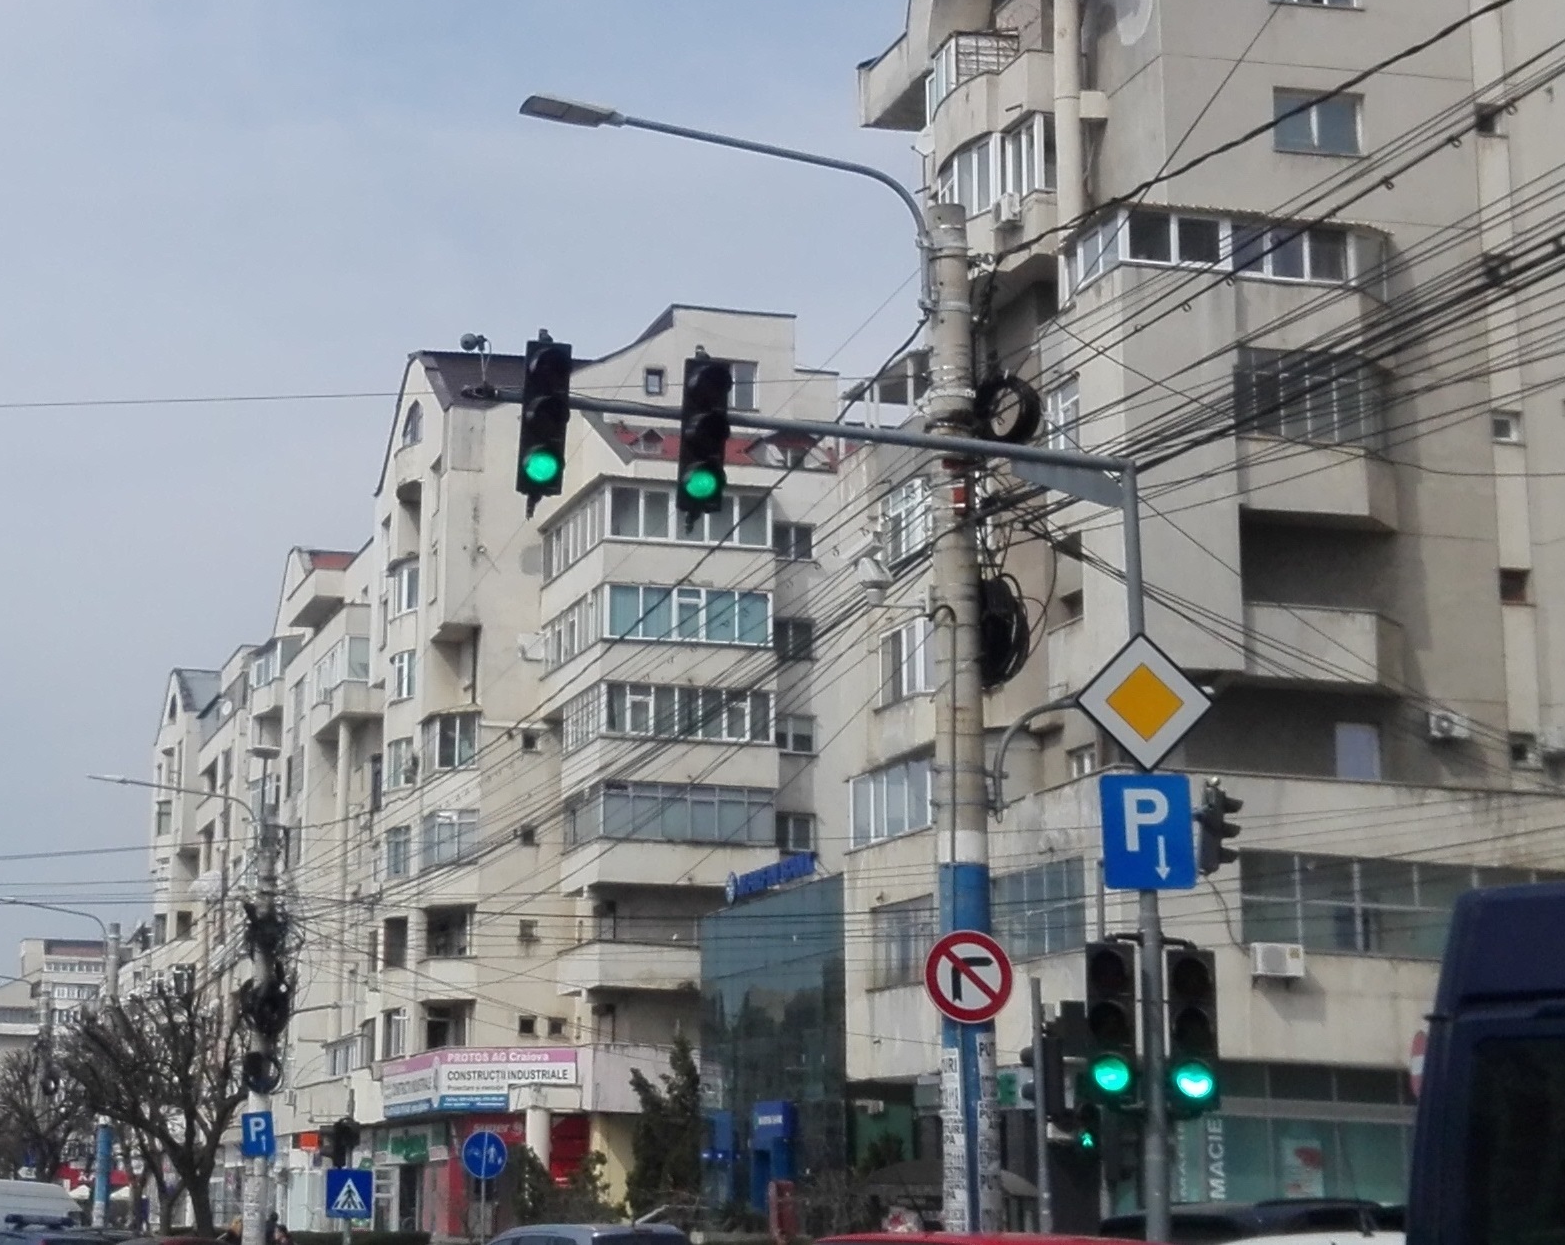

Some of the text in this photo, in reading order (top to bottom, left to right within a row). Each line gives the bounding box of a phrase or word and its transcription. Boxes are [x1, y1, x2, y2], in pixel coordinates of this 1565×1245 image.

[1123, 788, 1169, 852] P
[447, 1052, 490, 1063] PROTOS
[509, 1051, 549, 1062] Craiova
[507, 1068, 569, 1080] INDUSTRIALE
[249, 1116, 267, 1142] P
